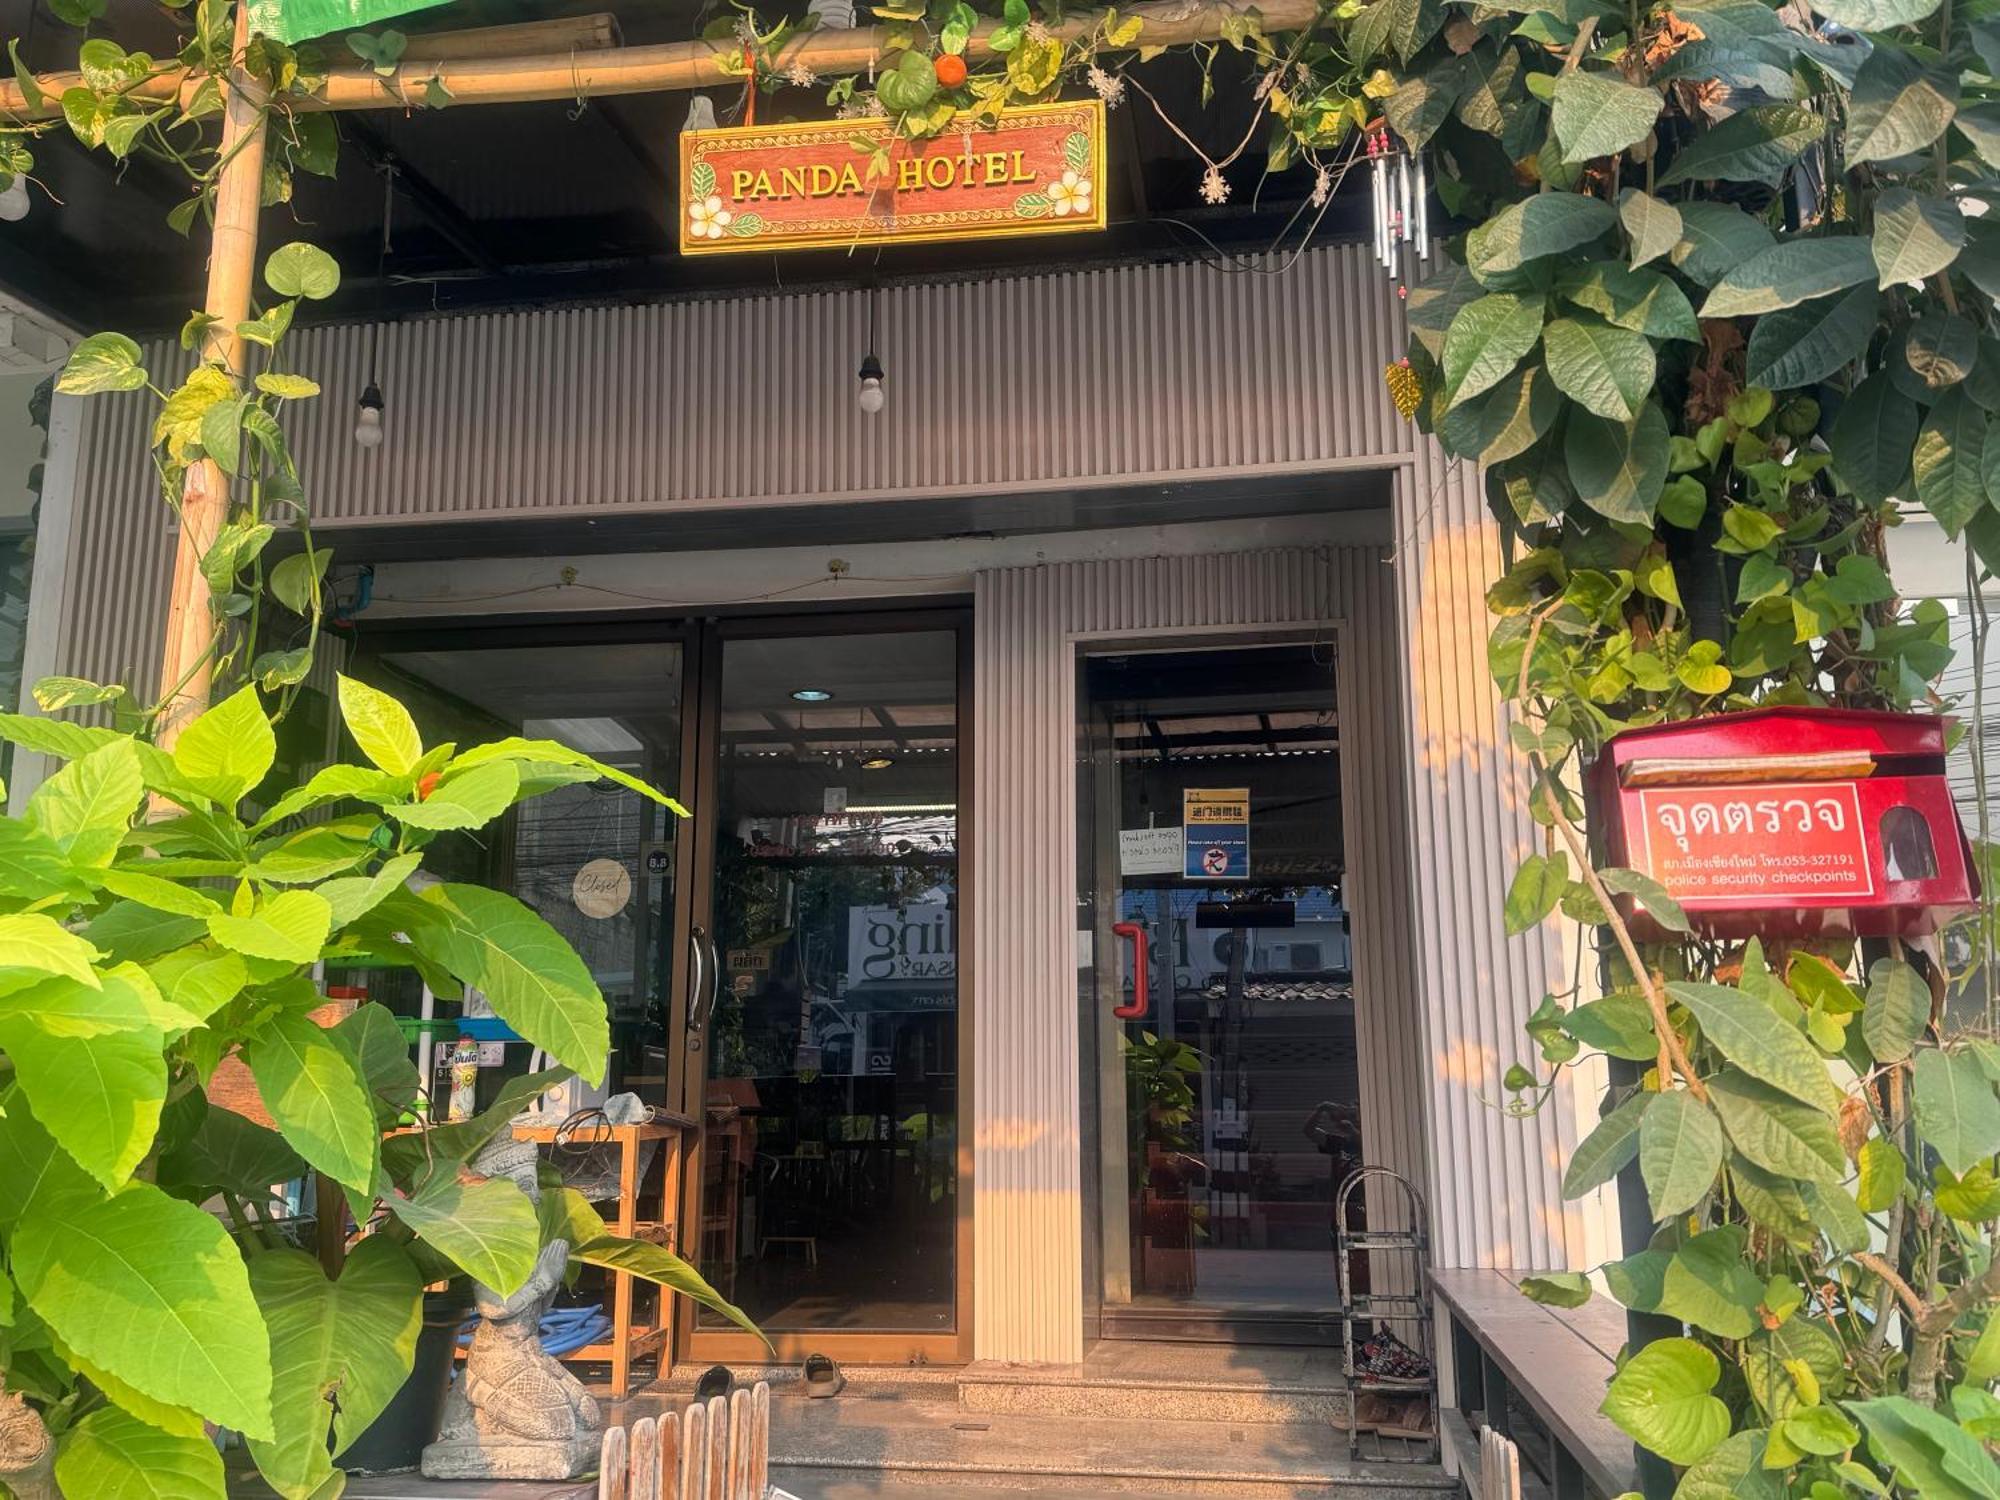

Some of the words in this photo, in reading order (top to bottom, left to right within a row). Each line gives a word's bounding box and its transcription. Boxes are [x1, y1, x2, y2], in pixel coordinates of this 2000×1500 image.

[731, 161, 864, 200] PANDA
[897, 149, 1038, 192] HOTEL
[1657, 797, 1846, 853] จุดตรวจ
[1663, 871, 1706, 888] police
[1711, 871, 1766, 887] security
[1771, 870, 1857, 886] checkpoints
